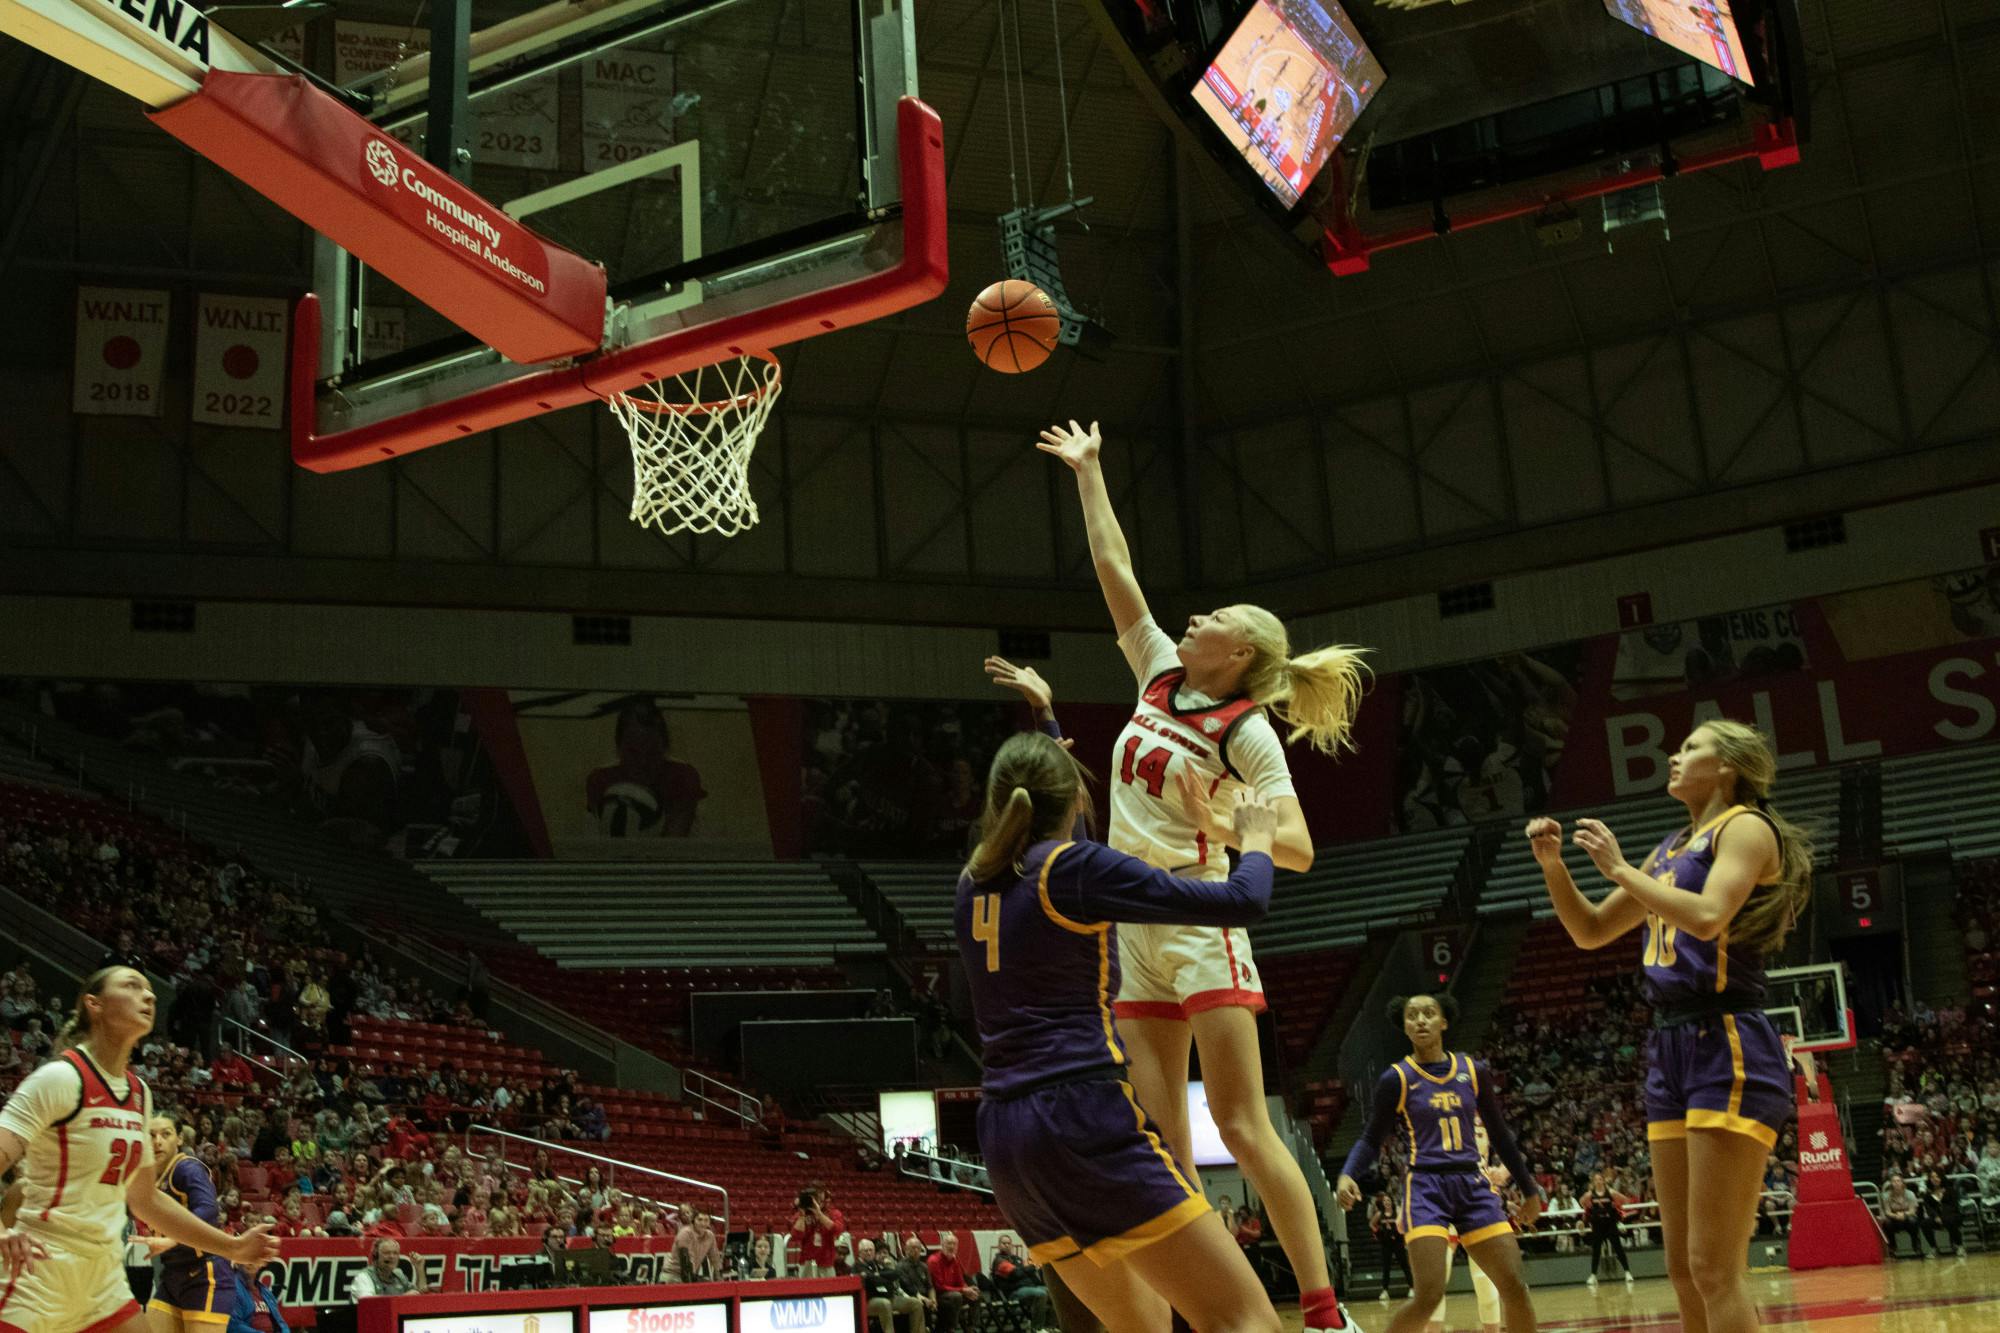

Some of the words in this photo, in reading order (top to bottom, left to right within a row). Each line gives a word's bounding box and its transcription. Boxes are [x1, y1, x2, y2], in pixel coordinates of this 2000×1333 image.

[106, 0, 209, 65] ENA
[596, 59, 656, 84] MAC
[480, 132, 543, 154] 2023
[402, 168, 501, 248] Community
[426, 209, 481, 256] Hospital
[484, 246, 545, 293] Anderson
[85, 300, 164, 324] W.N.I.T.
[205, 306, 282, 333] W.N.I.T.
[91, 383, 150, 402] 2018
[206, 393, 272, 416] 2022
[1928, 650, 2000, 741] S
[1121, 735, 1173, 798] 14
[1851, 883, 1872, 909] 5
[972, 893, 1001, 973] 4
[1433, 941, 1452, 966] 6
[922, 972, 940, 994] 7
[1438, 1116, 1463, 1151] 11
[1800, 1148, 1842, 1165] Ruoff
[254, 1256, 369, 1307] OME
[627, 1308, 695, 1333] Stoops
[774, 1303, 824, 1328] WMUN
